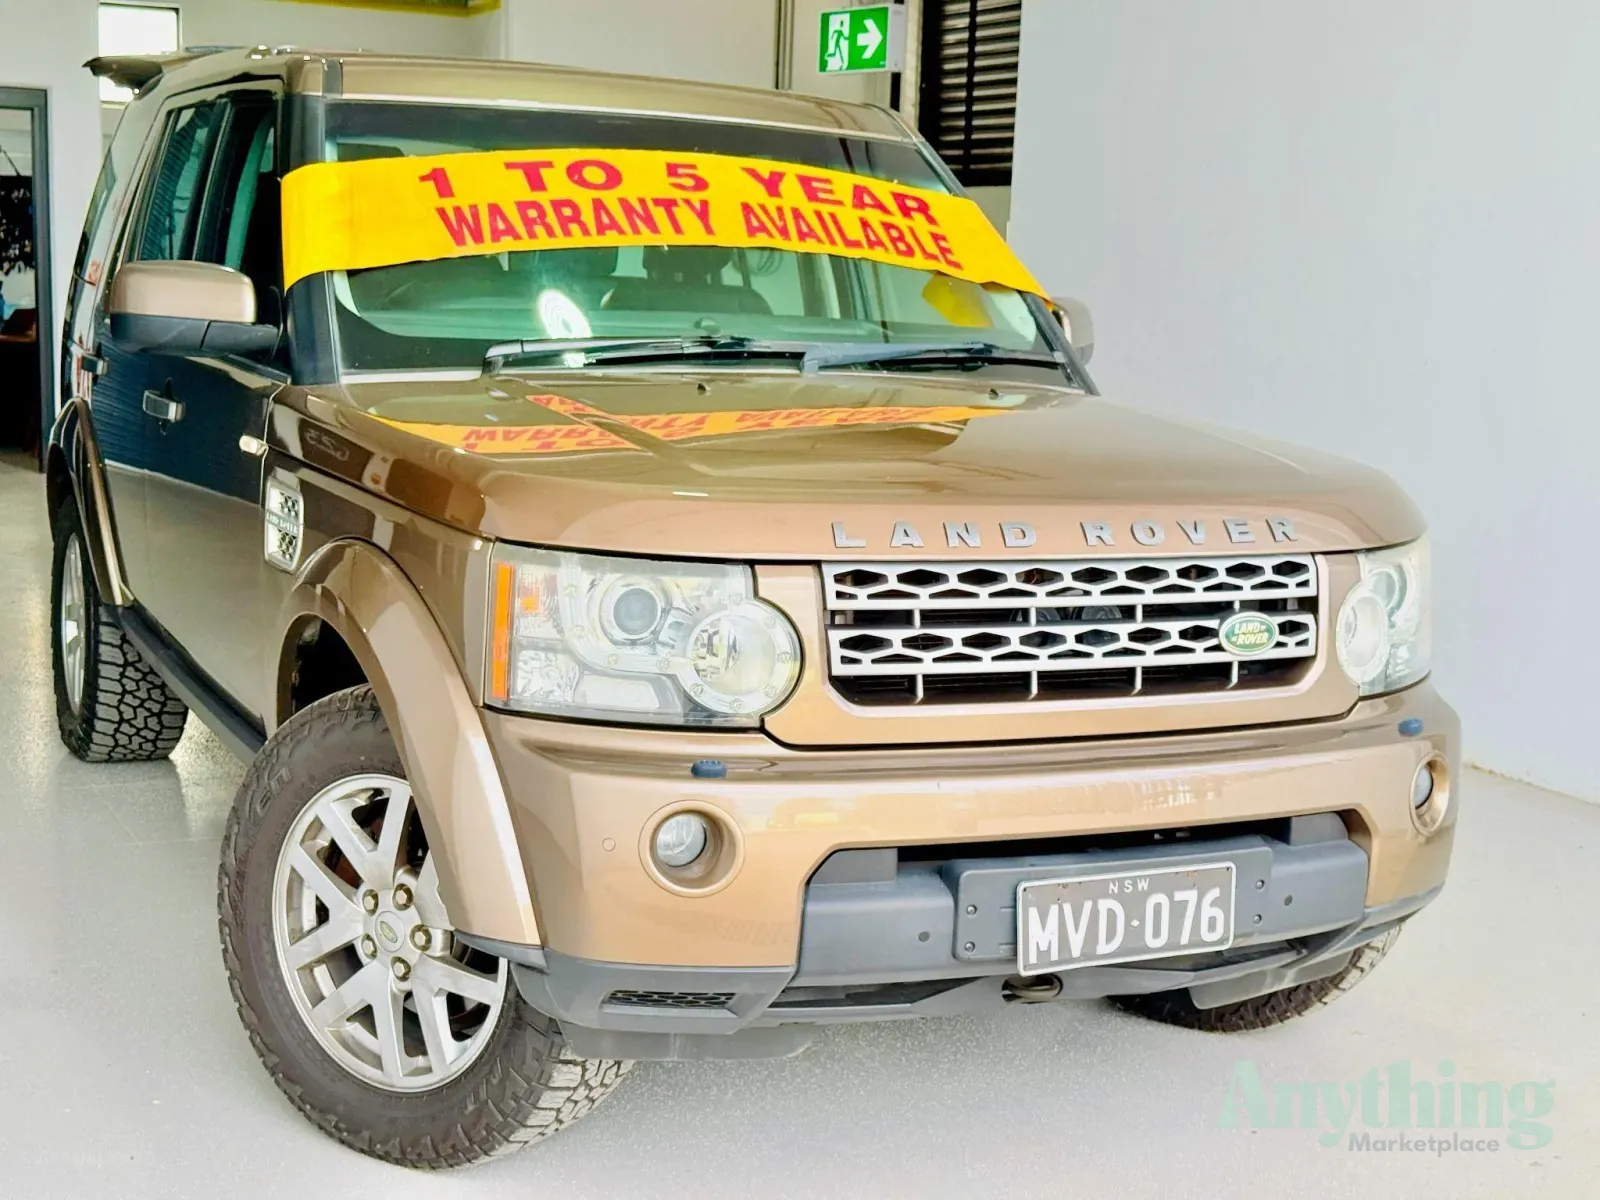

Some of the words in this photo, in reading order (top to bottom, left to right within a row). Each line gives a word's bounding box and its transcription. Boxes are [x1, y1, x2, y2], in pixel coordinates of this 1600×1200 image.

[418, 167, 455, 198] 1
[503, 159, 623, 192] TO
[665, 161, 710, 192] 5
[739, 166, 940, 228] YEAR
[435, 197, 716, 247] WARRANTY
[740, 201, 963, 270] AVAILABLE
[831, 520, 1036, 549] LAND
[1080, 517, 1300, 547] ROVER
[1234, 622, 1261, 635] LAND
[1237, 631, 1269, 645] ROVER
[1108, 878, 1150, 894] NSW
